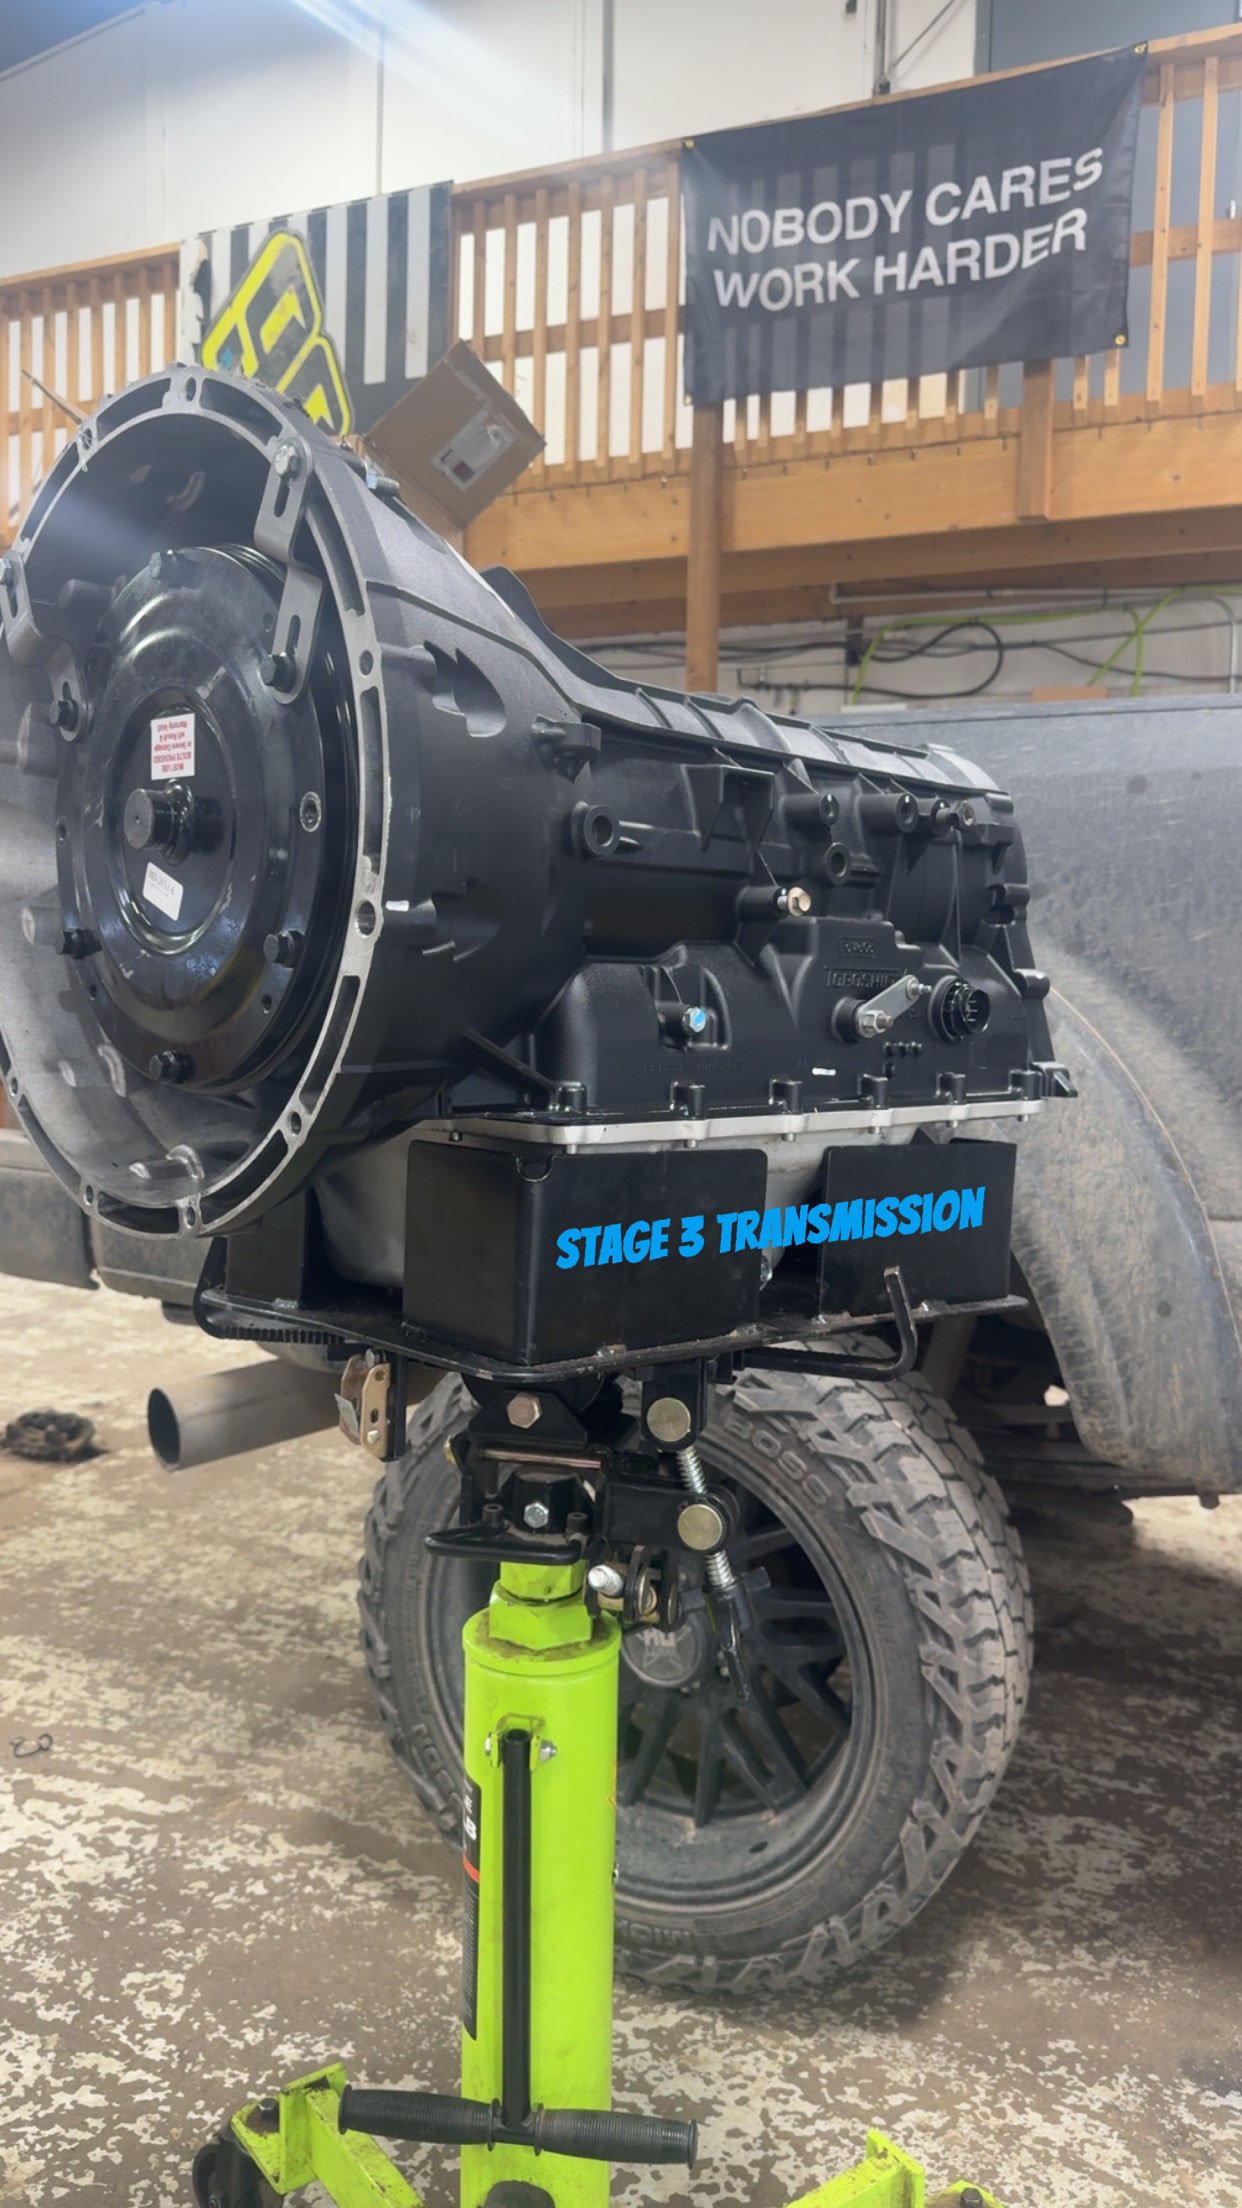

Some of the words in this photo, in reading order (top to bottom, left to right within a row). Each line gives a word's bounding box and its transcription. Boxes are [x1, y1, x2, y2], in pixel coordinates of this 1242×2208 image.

[707, 189, 912, 255] NOBODY
[925, 147, 1103, 227] CARES
[713, 258, 861, 311] WORK
[873, 207, 1087, 296] HARDER
[823, 965, 906, 989] TORQSHIF
[723, 1418, 832, 1505] BOSS
